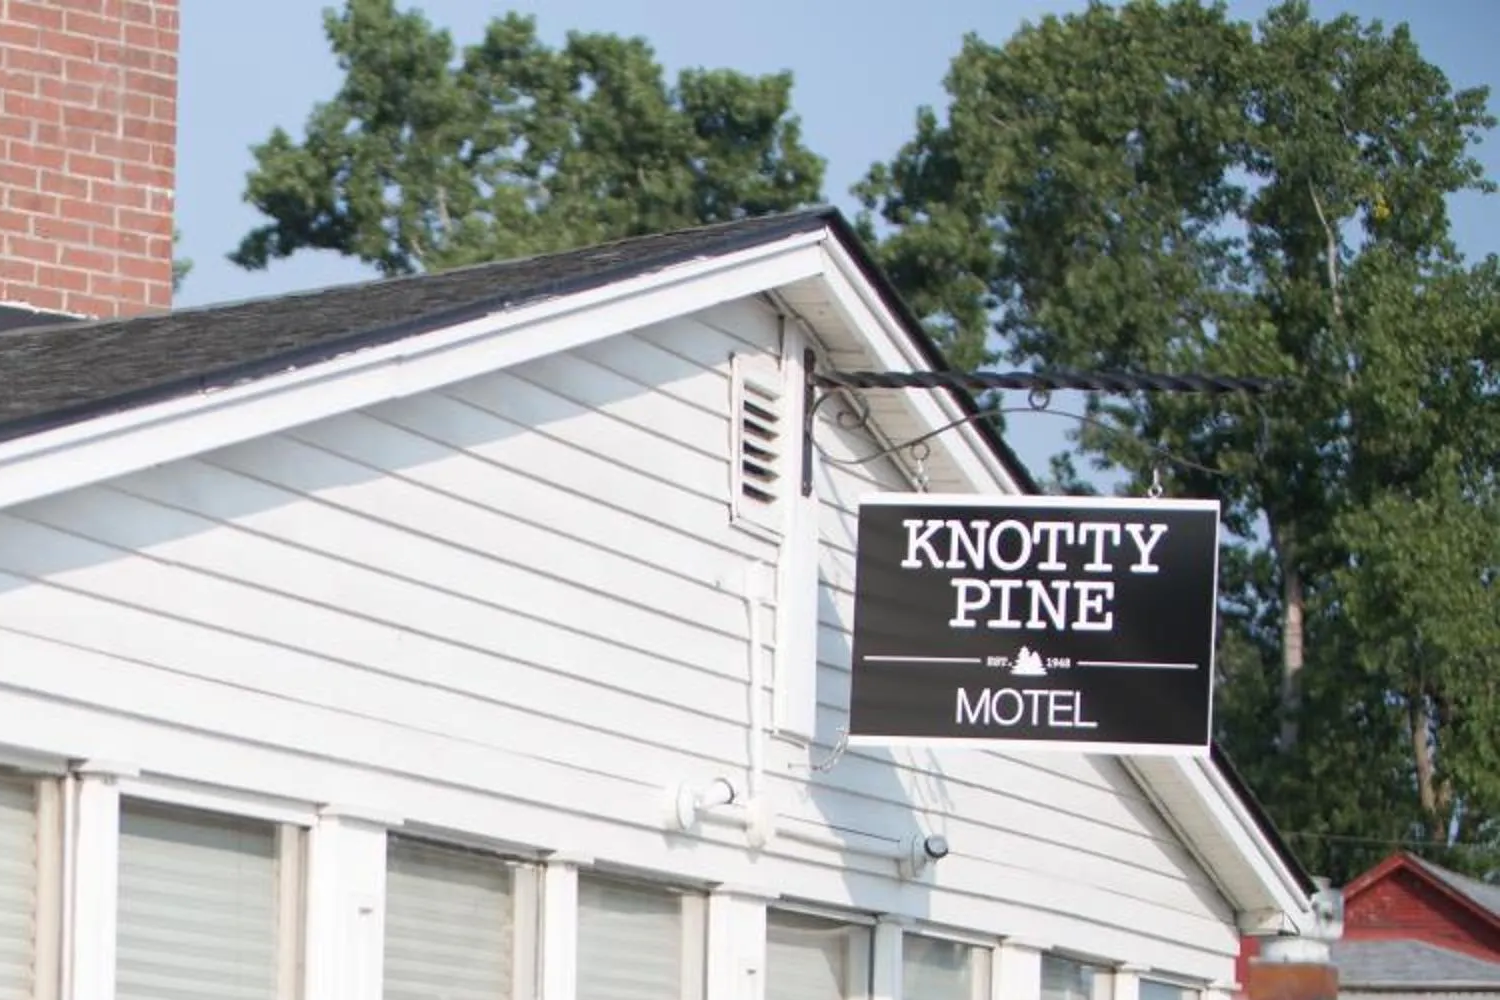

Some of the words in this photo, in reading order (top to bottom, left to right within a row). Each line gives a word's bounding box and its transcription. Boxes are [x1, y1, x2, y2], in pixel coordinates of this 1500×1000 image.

[900, 518, 1168, 574] KNOTTY
[948, 577, 1116, 632] PINE
[955, 687, 1099, 728] MOTEL
